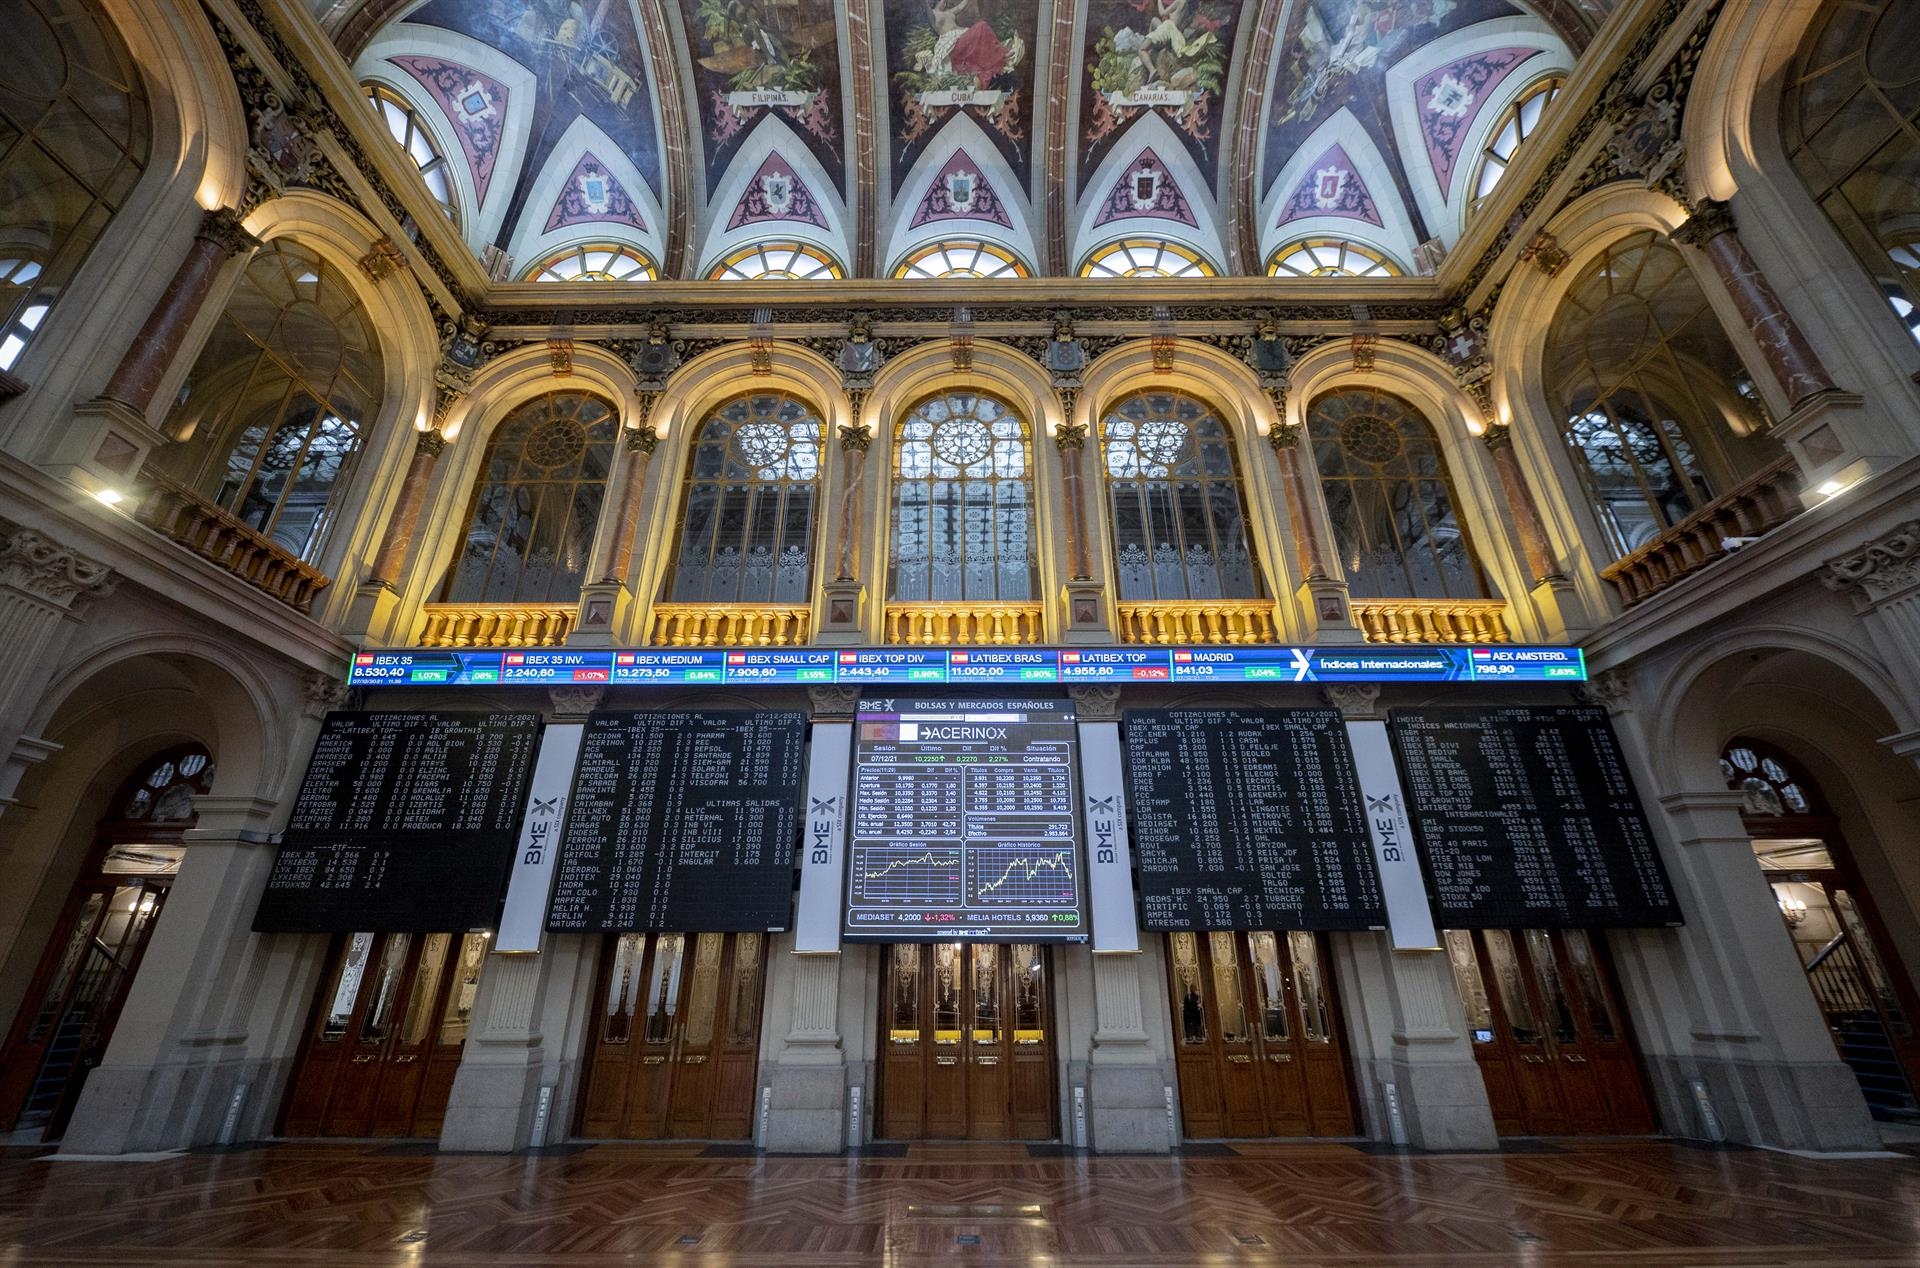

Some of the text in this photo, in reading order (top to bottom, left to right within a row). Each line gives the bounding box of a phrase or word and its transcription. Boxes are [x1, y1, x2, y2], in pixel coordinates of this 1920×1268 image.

[376, 656, 412, 665] IBEX 35
[526, 656, 584, 664] IBEX 35 INV.
[636, 656, 702, 664] IBEX MEDIUM
[747, 655, 830, 664] IBEX SMALL CAP
[858, 654, 925, 663] IBEX TOP DIV
[970, 654, 1042, 663] LATIBEX BRAS
[1082, 654, 1146, 662] LATIBEX TOP
[1194, 653, 1234, 662] MADRID
[1492, 652, 1568, 660] AEX AMSTERD.
[1320, 658, 1444, 669] Índices Internacionales
[354, 668, 441, 680] 8.530,40 1,07%
[506, 668, 604, 680] 2.240,60 -1,07%
[616, 668, 670, 678] 13.273,50
[840, 668, 889, 677] 2.443,40
[952, 667, 1004, 676] 11.002,00
[1064, 667, 1114, 676] 4.955,80
[1176, 666, 1212, 676] 841,03
[1475, 665, 1514, 674] 798,90
[860, 701, 882, 710] BME
[1008, 700, 1054, 710] ESPAÑOLES
[931, 727, 1007, 740] ACERINOX
[524, 822, 548, 864] BME
[812, 820, 830, 864] BME
[1095, 820, 1114, 864] BME
[1376, 818, 1401, 862] BME
[898, 914, 921, 922] 4,2000
[932, 914, 956, 922] -1,32%
